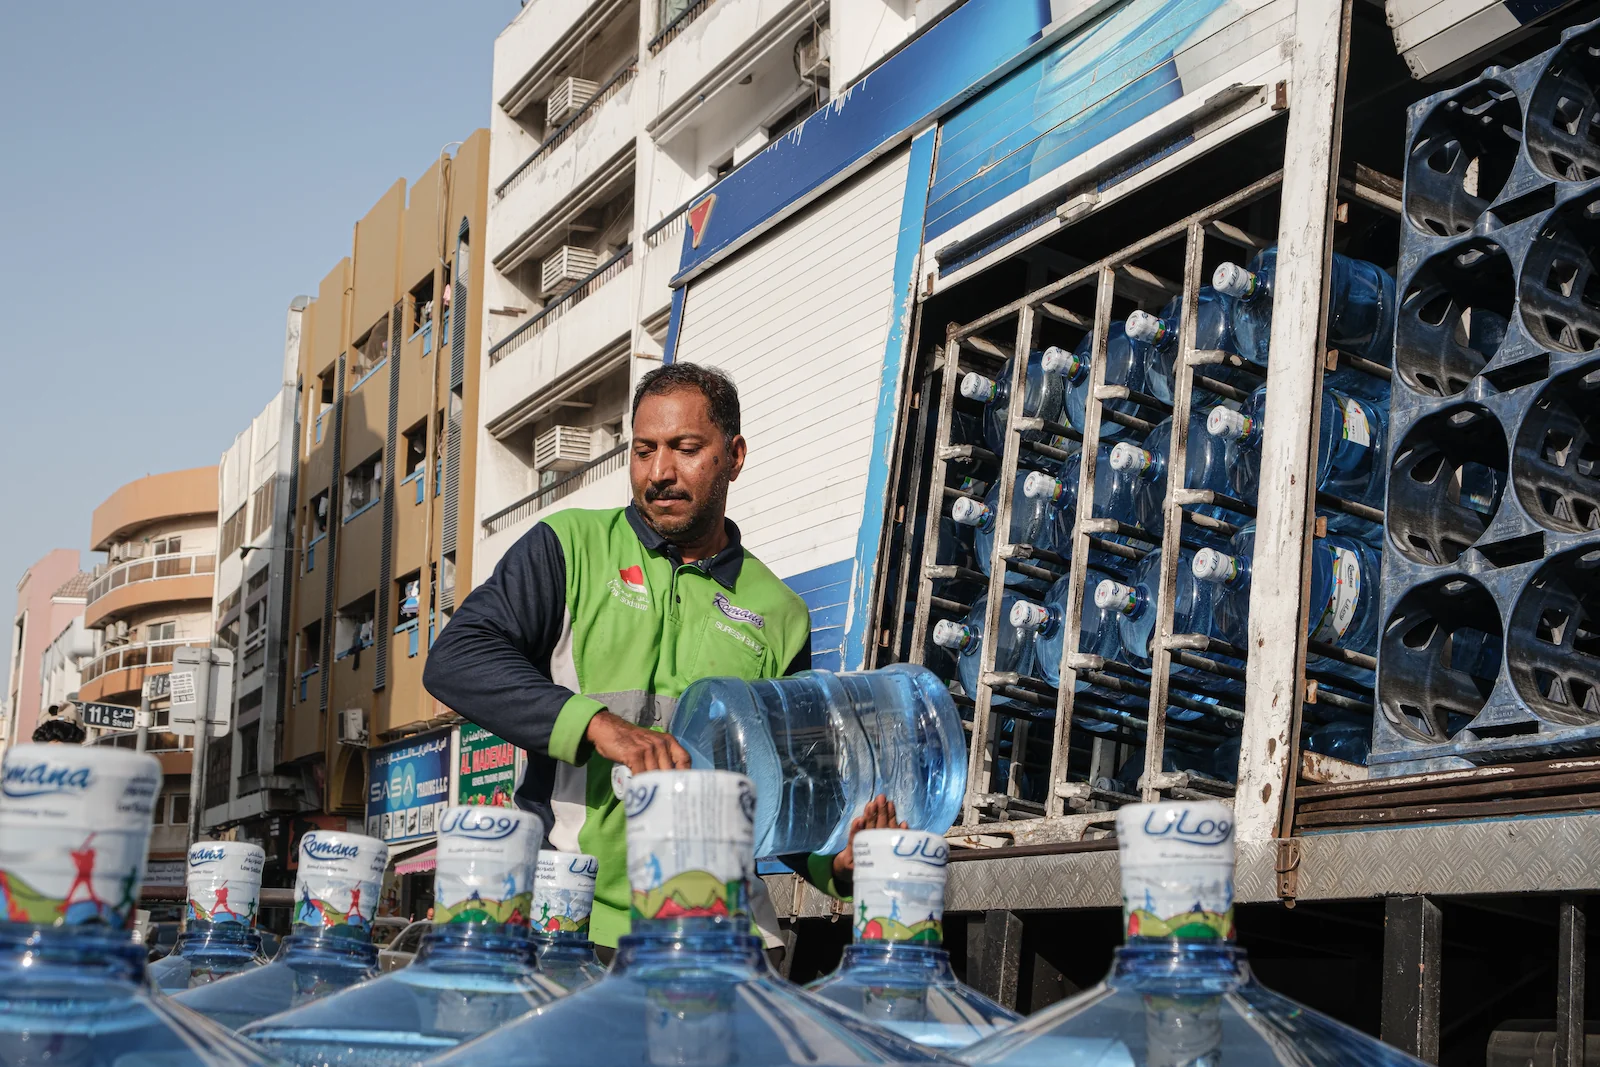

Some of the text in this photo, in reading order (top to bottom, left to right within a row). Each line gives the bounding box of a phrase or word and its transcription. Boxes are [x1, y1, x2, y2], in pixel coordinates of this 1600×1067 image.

[712, 592, 765, 629] Romana
[88, 706, 102, 723] 11
[102, 714, 133, 728] a Street
[112, 708, 134, 720] شارع
[460, 752, 471, 776] AL
[3, 763, 93, 793] mana
[370, 774, 413, 802] SASA
[190, 848, 227, 866] mana
[302, 834, 360, 860] Romana
